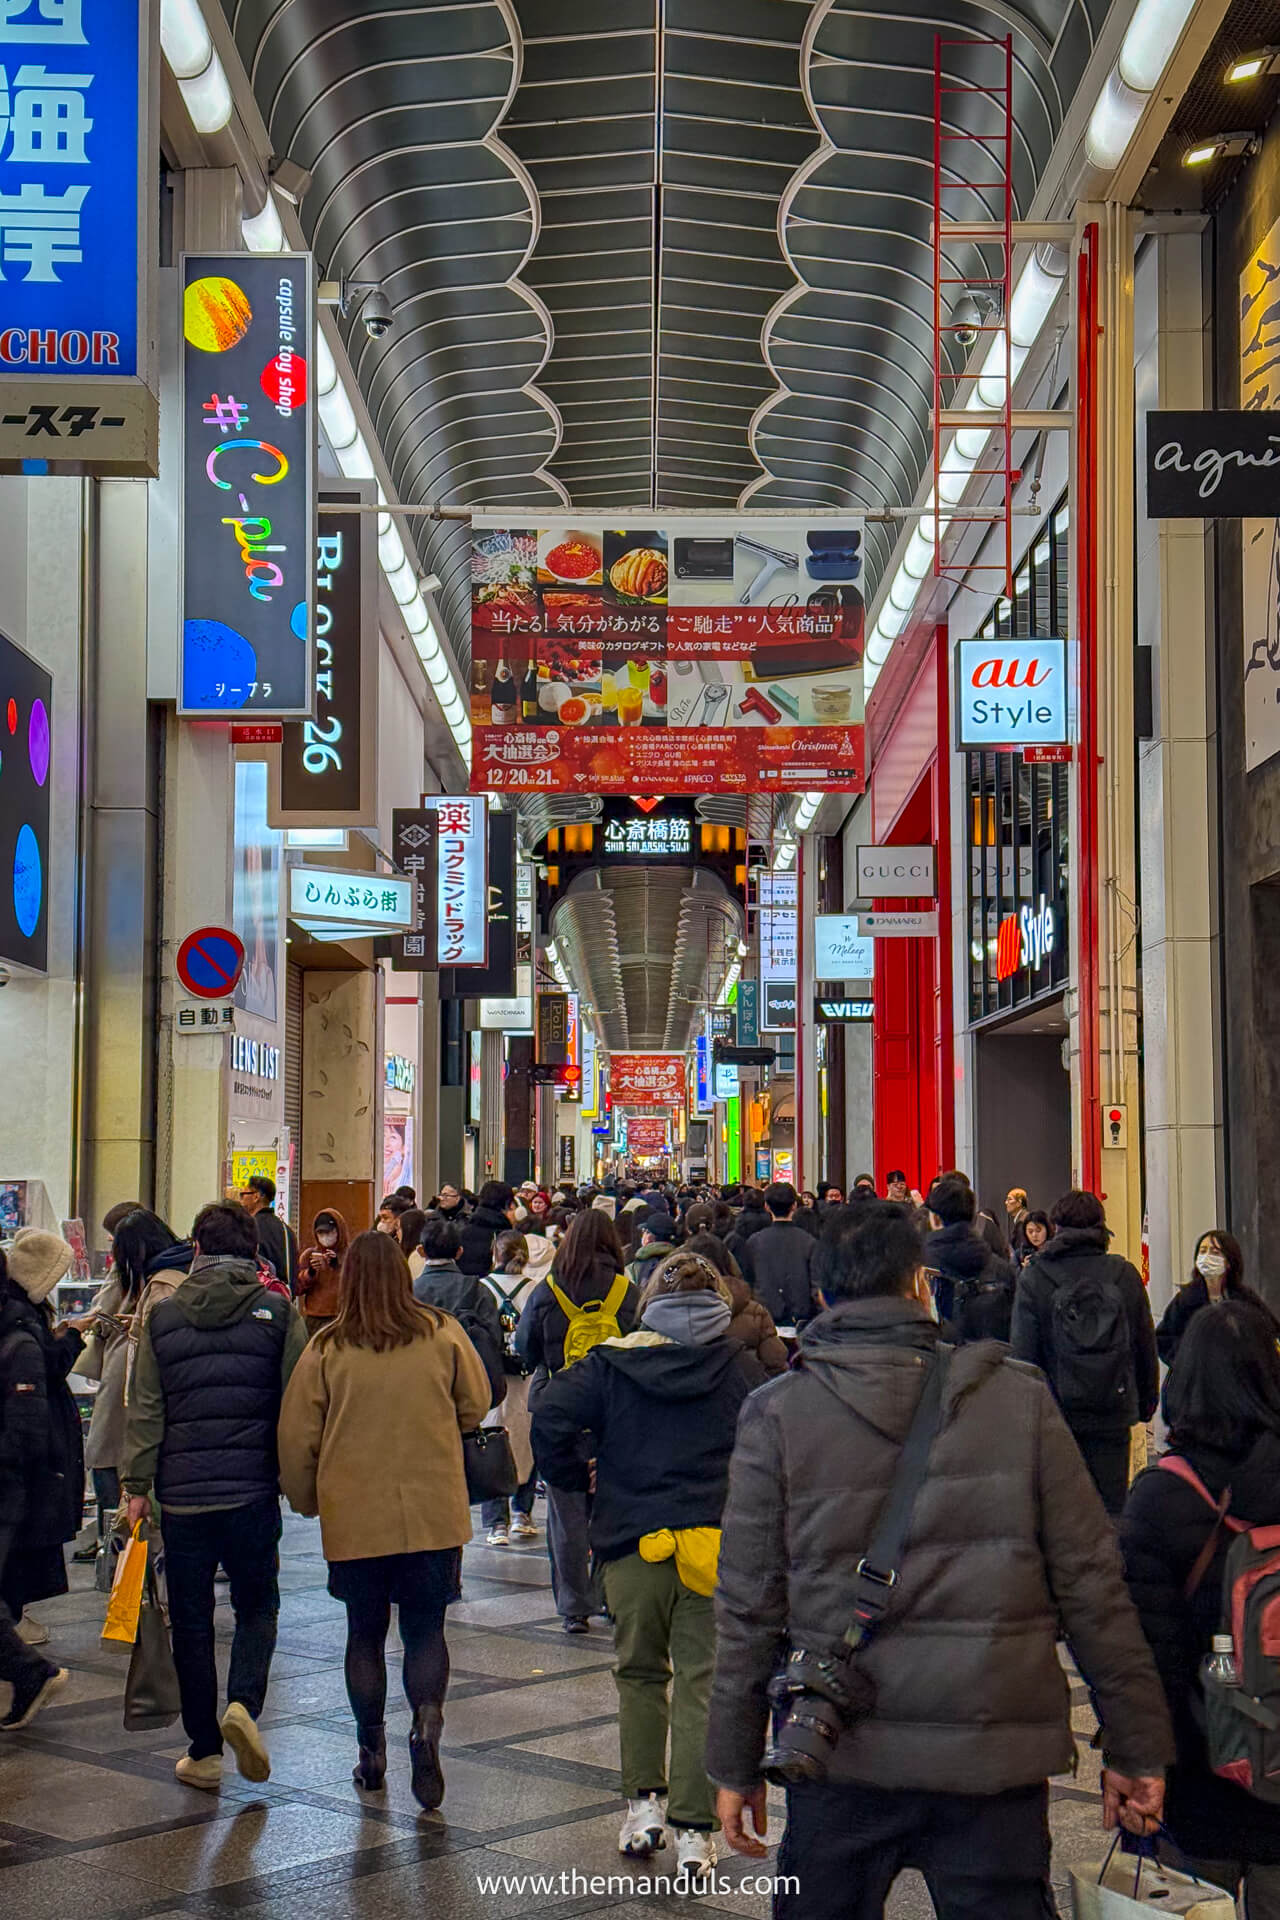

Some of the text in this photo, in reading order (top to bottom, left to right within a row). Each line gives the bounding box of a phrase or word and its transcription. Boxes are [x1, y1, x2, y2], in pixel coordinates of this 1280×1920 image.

[274, 278, 297, 417] capsule toy shop
[971, 659, 1053, 688] au
[215, 682, 273, 697] シープラ
[971, 700, 1053, 728] Style
[303, 716, 342, 774] 26
[791, 740, 838, 751] Christmas
[438, 803, 471, 834] 薬
[605, 818, 690, 840] 心斎橋筋
[862, 865, 929, 878] GUCCI
[305, 882, 398, 913] しんぶら街
[444, 840, 466, 961] コクミンドラッグ
[1020, 892, 1054, 972] Style
[820, 1003, 875, 1017] EVISU
